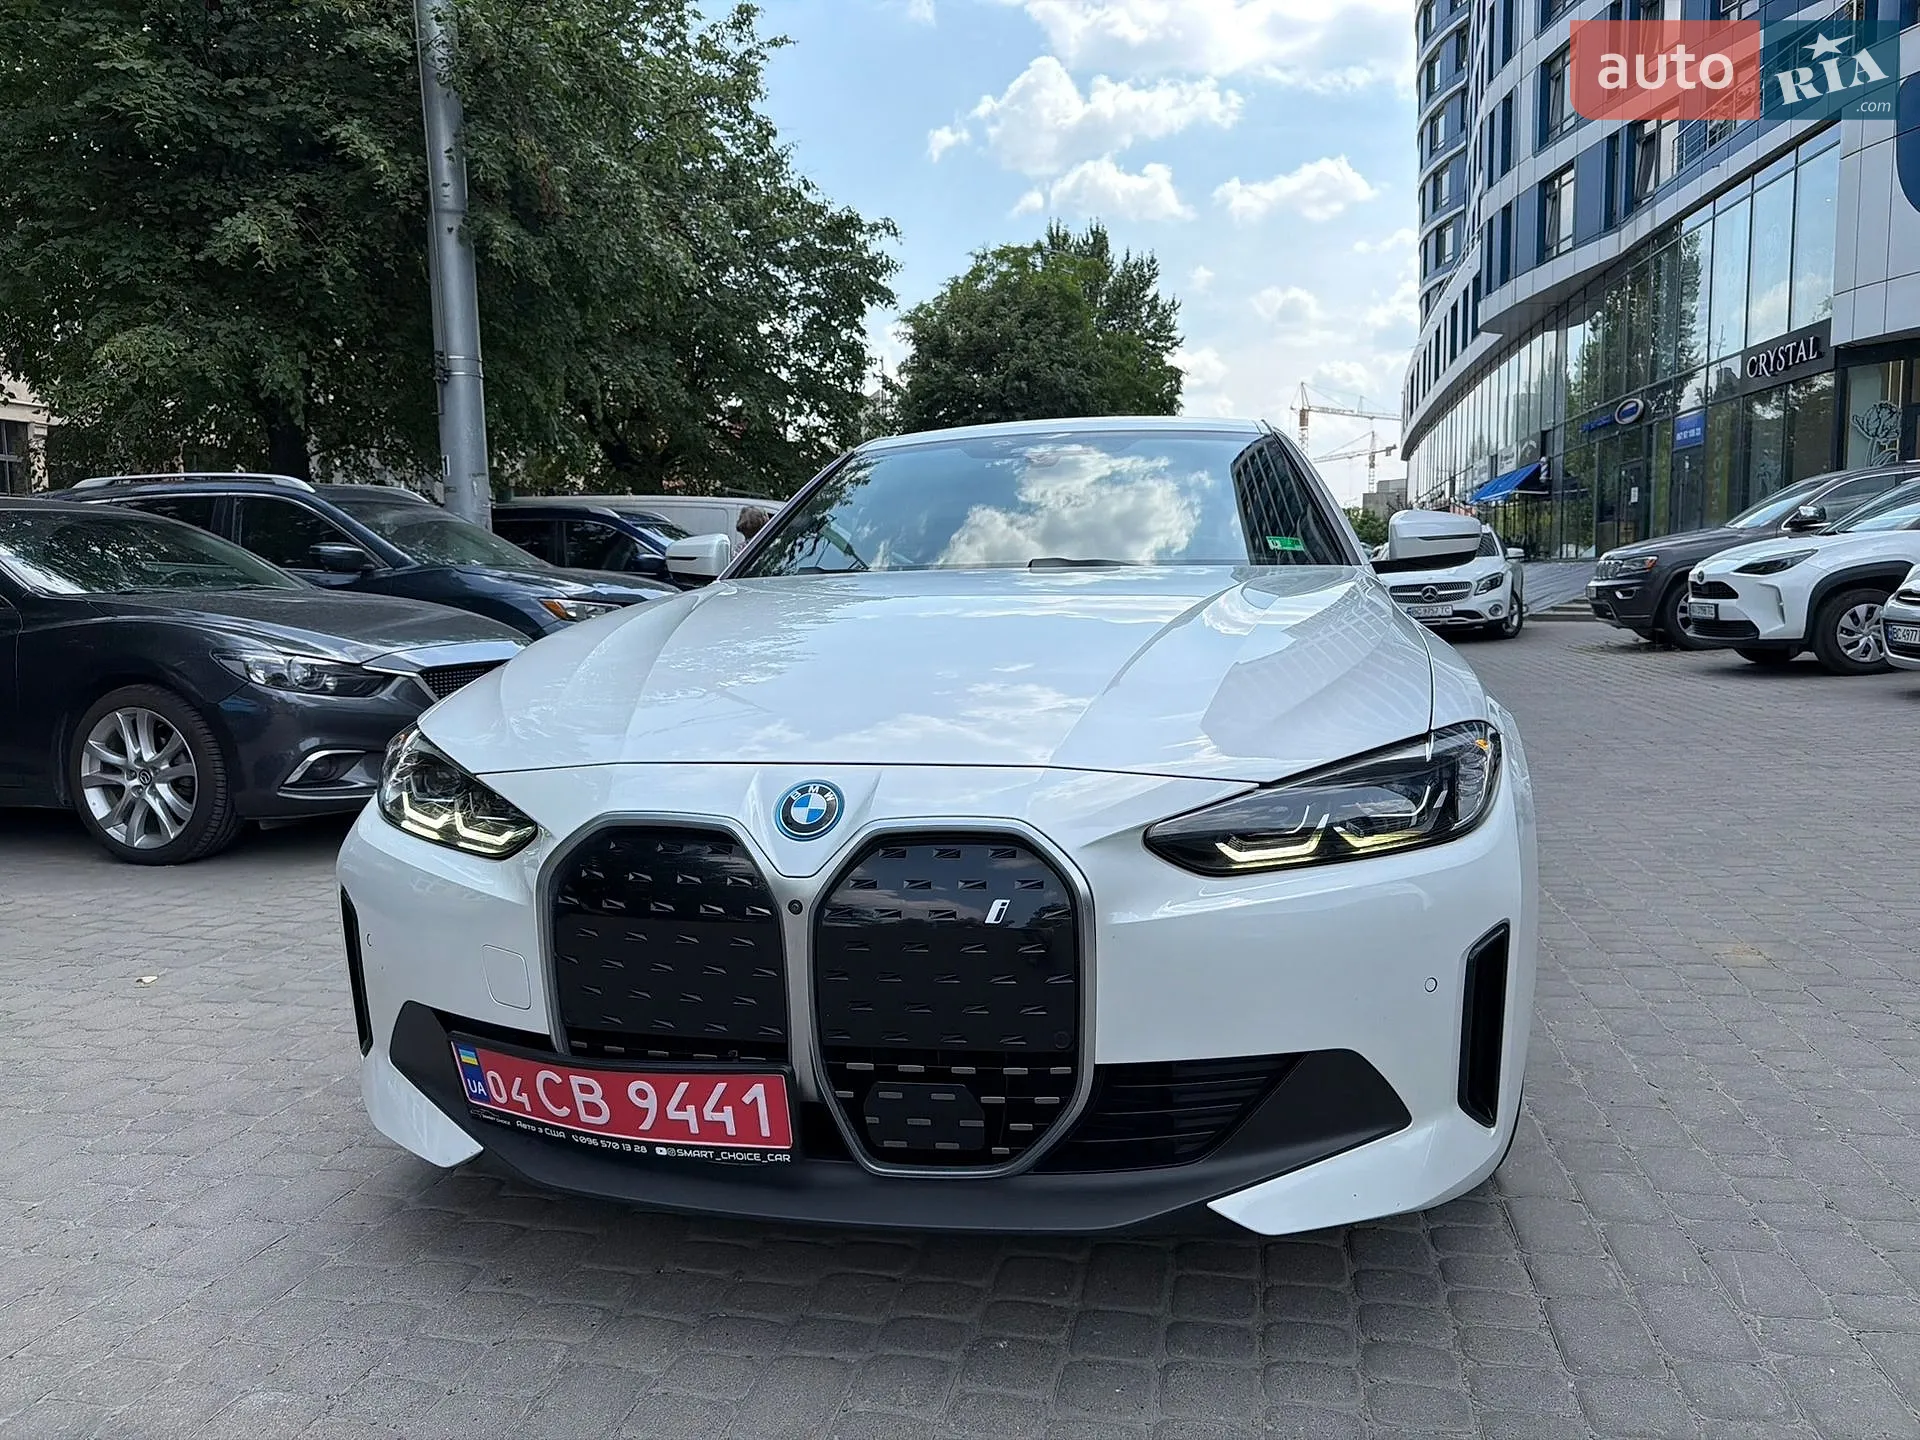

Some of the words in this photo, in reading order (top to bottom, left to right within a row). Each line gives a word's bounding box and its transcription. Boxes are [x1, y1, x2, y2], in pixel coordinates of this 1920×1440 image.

[1746, 336, 1818, 378] CRYSTAL
[790, 785, 836, 802] BMW
[467, 1078, 487, 1097] UA
[627, 1080, 771, 1138] 9441
[579, 1135, 599, 1146] 096
[600, 1139, 620, 1150] 570
[622, 1143, 632, 1152] 13
[633, 1145, 648, 1154] 28
